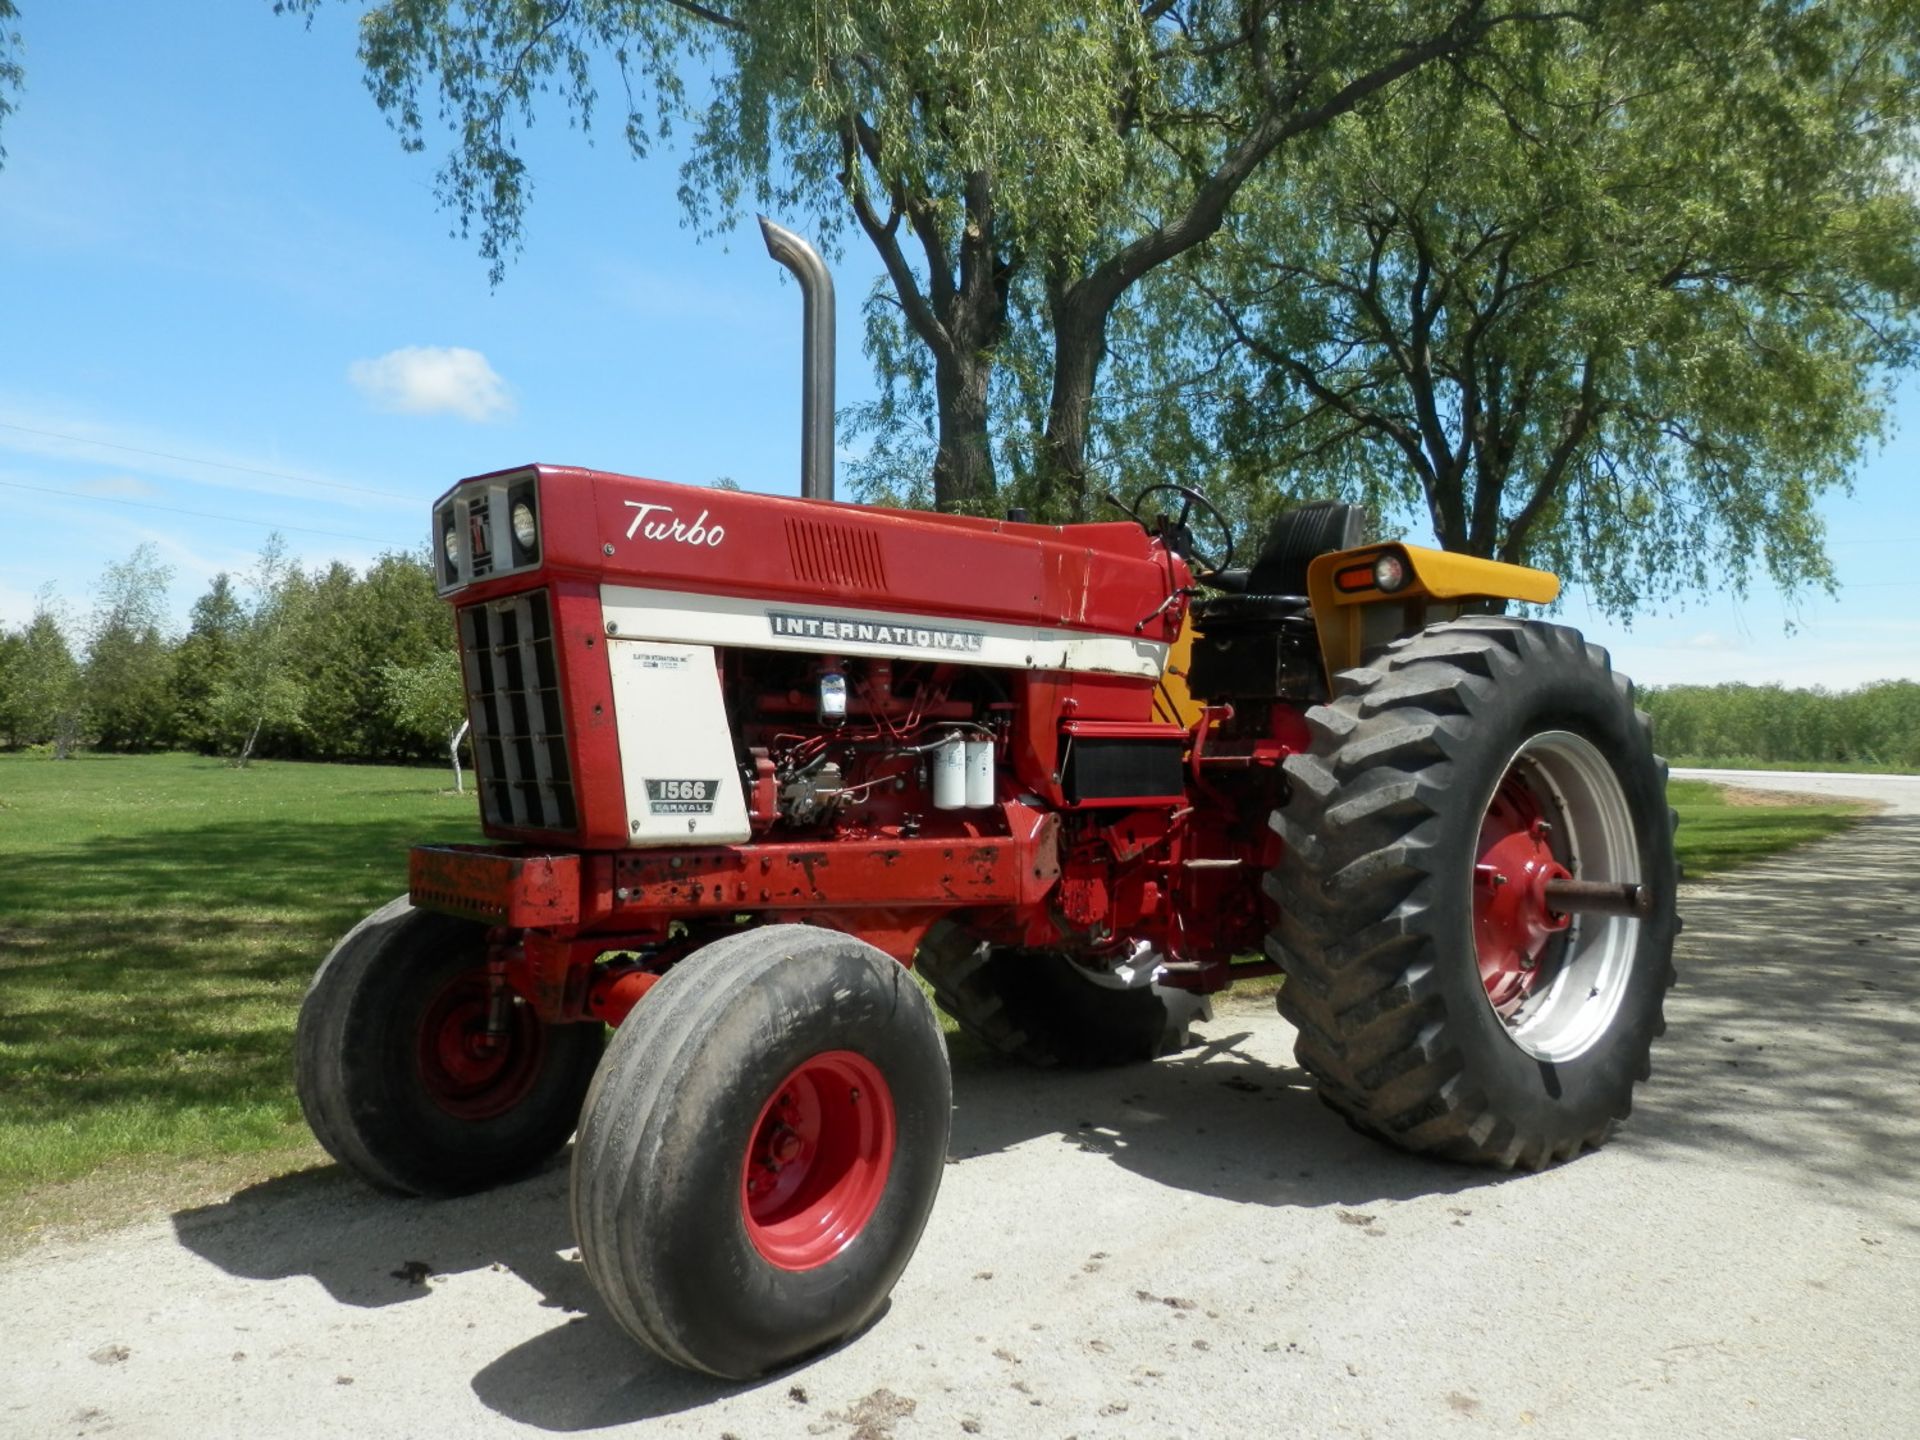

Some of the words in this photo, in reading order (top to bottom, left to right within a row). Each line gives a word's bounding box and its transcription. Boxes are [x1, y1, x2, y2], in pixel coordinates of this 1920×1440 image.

[624, 500, 725, 546] Turbo
[775, 616, 980, 650] INTERNATIONAL
[660, 781, 706, 799] 1566
